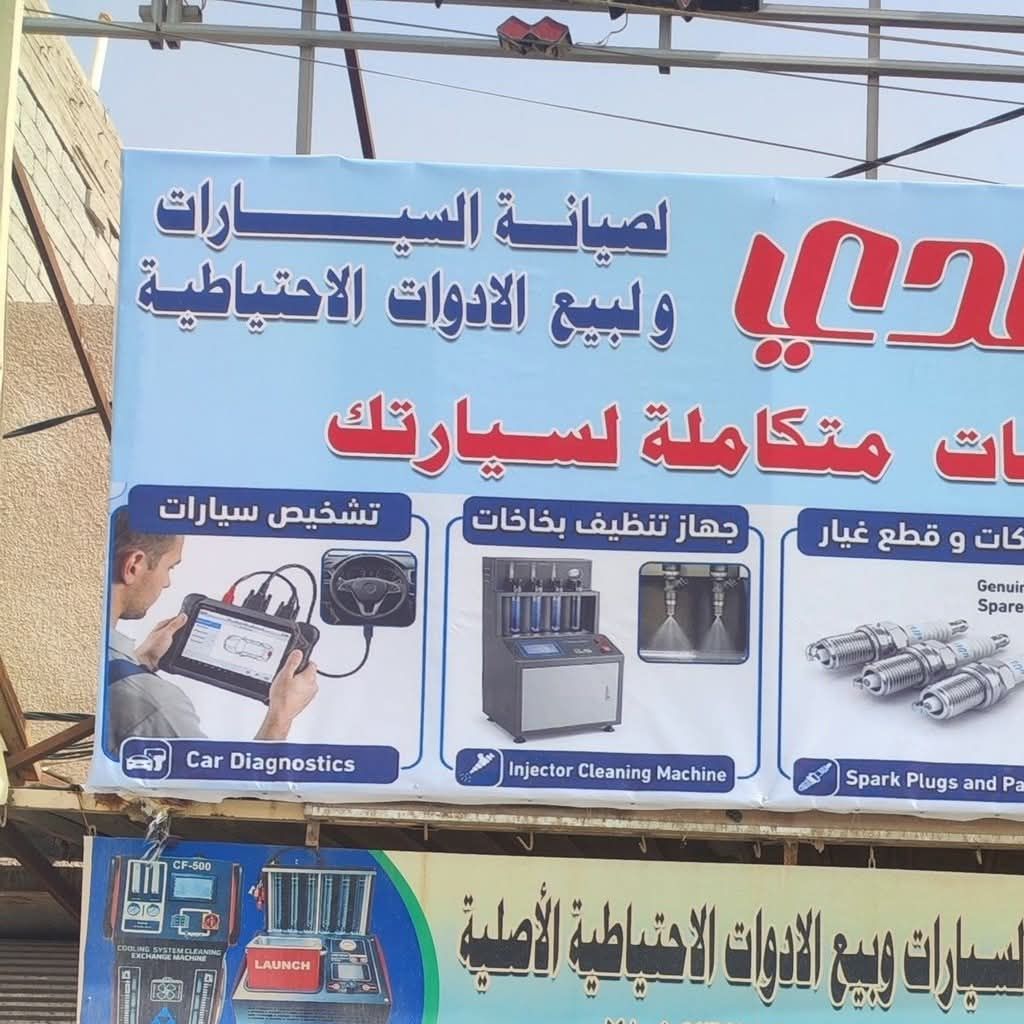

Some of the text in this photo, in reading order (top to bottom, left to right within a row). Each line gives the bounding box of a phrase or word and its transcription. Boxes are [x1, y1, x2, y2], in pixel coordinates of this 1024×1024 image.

[154, 178, 671, 264] لصيانة السيارات
[136, 256, 367, 332] الاحتياطية
[385, 267, 527, 340] الادوات
[324, 391, 621, 479] لسيارتك
[639, 401, 894, 483] متكاملة
[159, 495, 381, 530] تشخيص سيارات
[471, 507, 739, 544] جهاز تنظيف بخاخات
[818, 518, 869, 548] غيار
[878, 521, 940, 551] قطع
[949, 531, 966, 554] و
[977, 599, 1024, 615] Spare
[186, 751, 356, 774] Car Diagnostics
[508, 761, 728, 783] Injector Cleaning Machine
[846, 770, 901, 788] Spark
[906, 772, 958, 792] Plugs
[963, 774, 997, 790] and
[172, 861, 212, 871] CF-500
[457, 881, 561, 992] الأصلية
[568, 898, 717, 1000] الاحتياطية
[254, 959, 311, 971] LAUNCH
[724, 907, 821, 1007] الادوات
[830, 929, 896, 1010] وبيع
